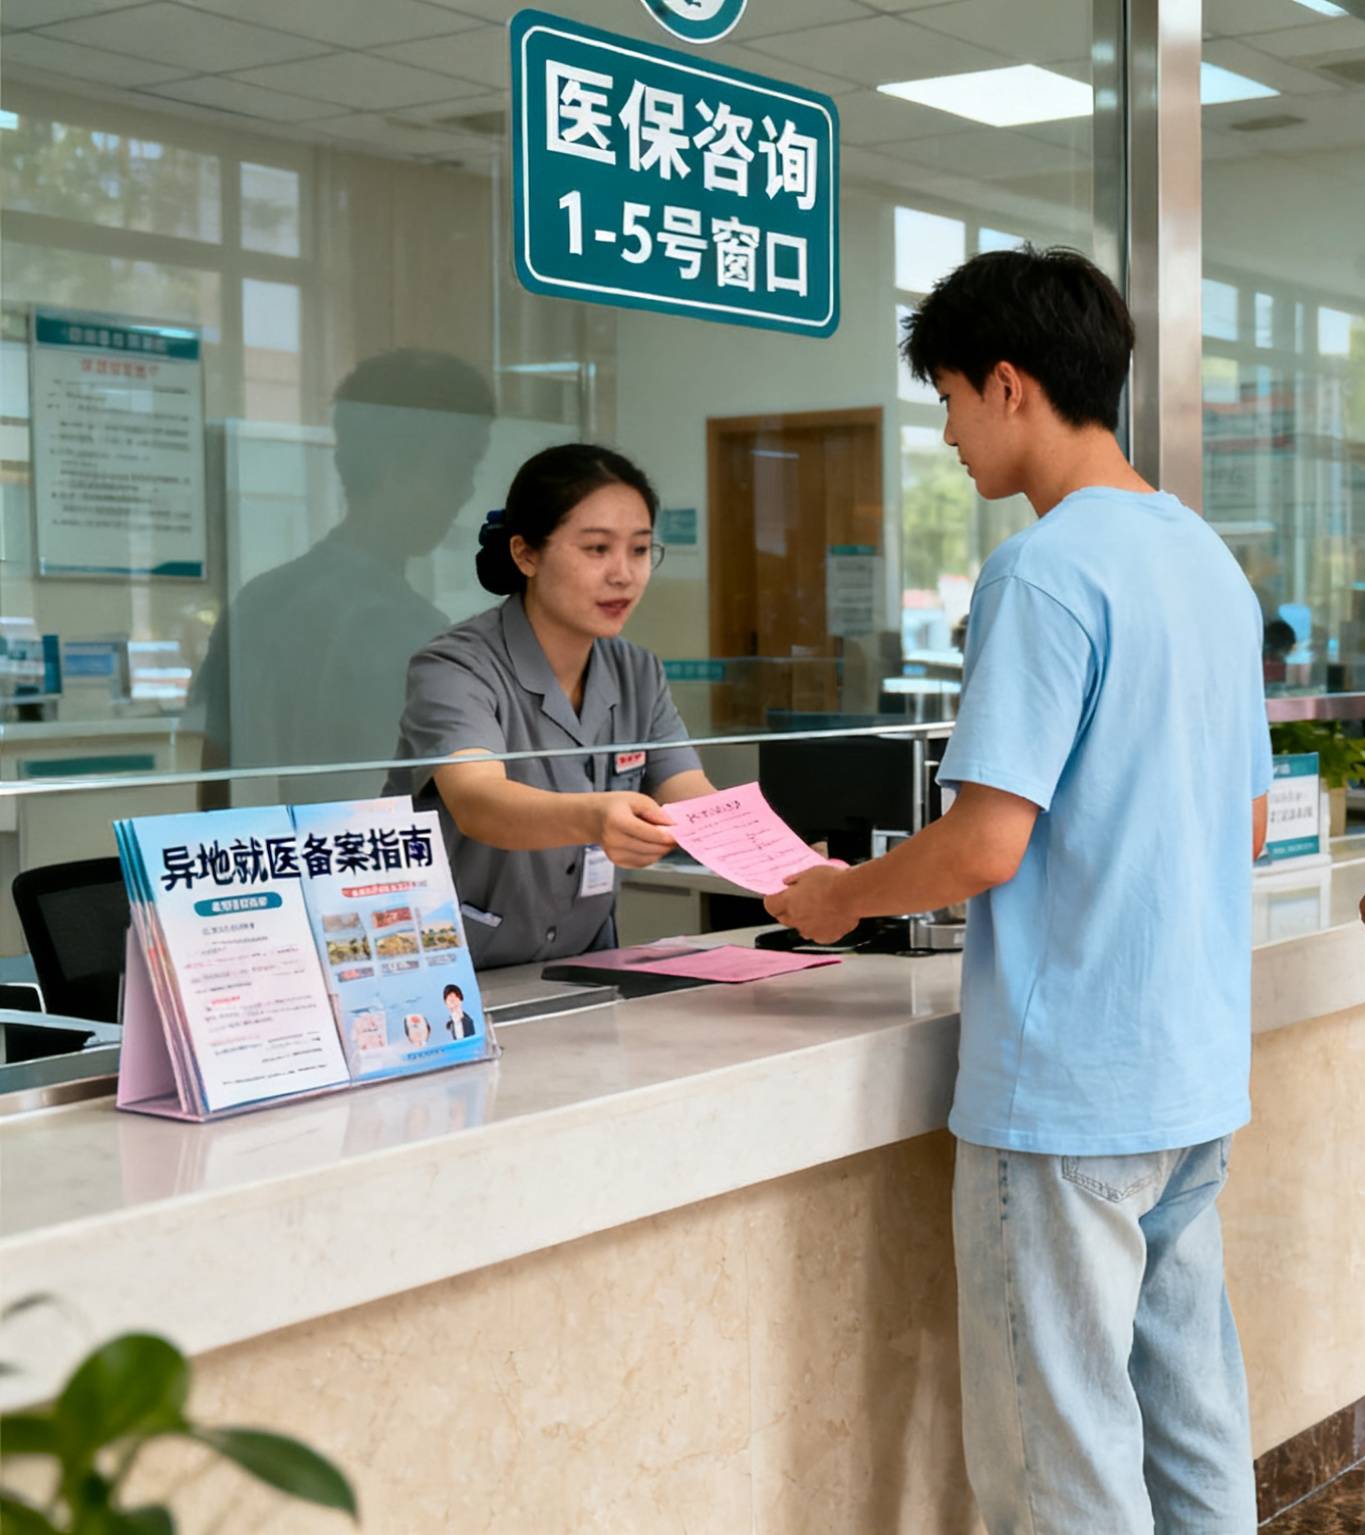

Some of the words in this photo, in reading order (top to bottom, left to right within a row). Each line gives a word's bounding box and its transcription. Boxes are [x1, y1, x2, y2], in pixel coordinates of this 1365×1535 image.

[545, 59, 819, 211] 医保咨询
[558, 190, 808, 298] 1-5号窗口
[160, 825, 433, 891] 异地就医备案指南
